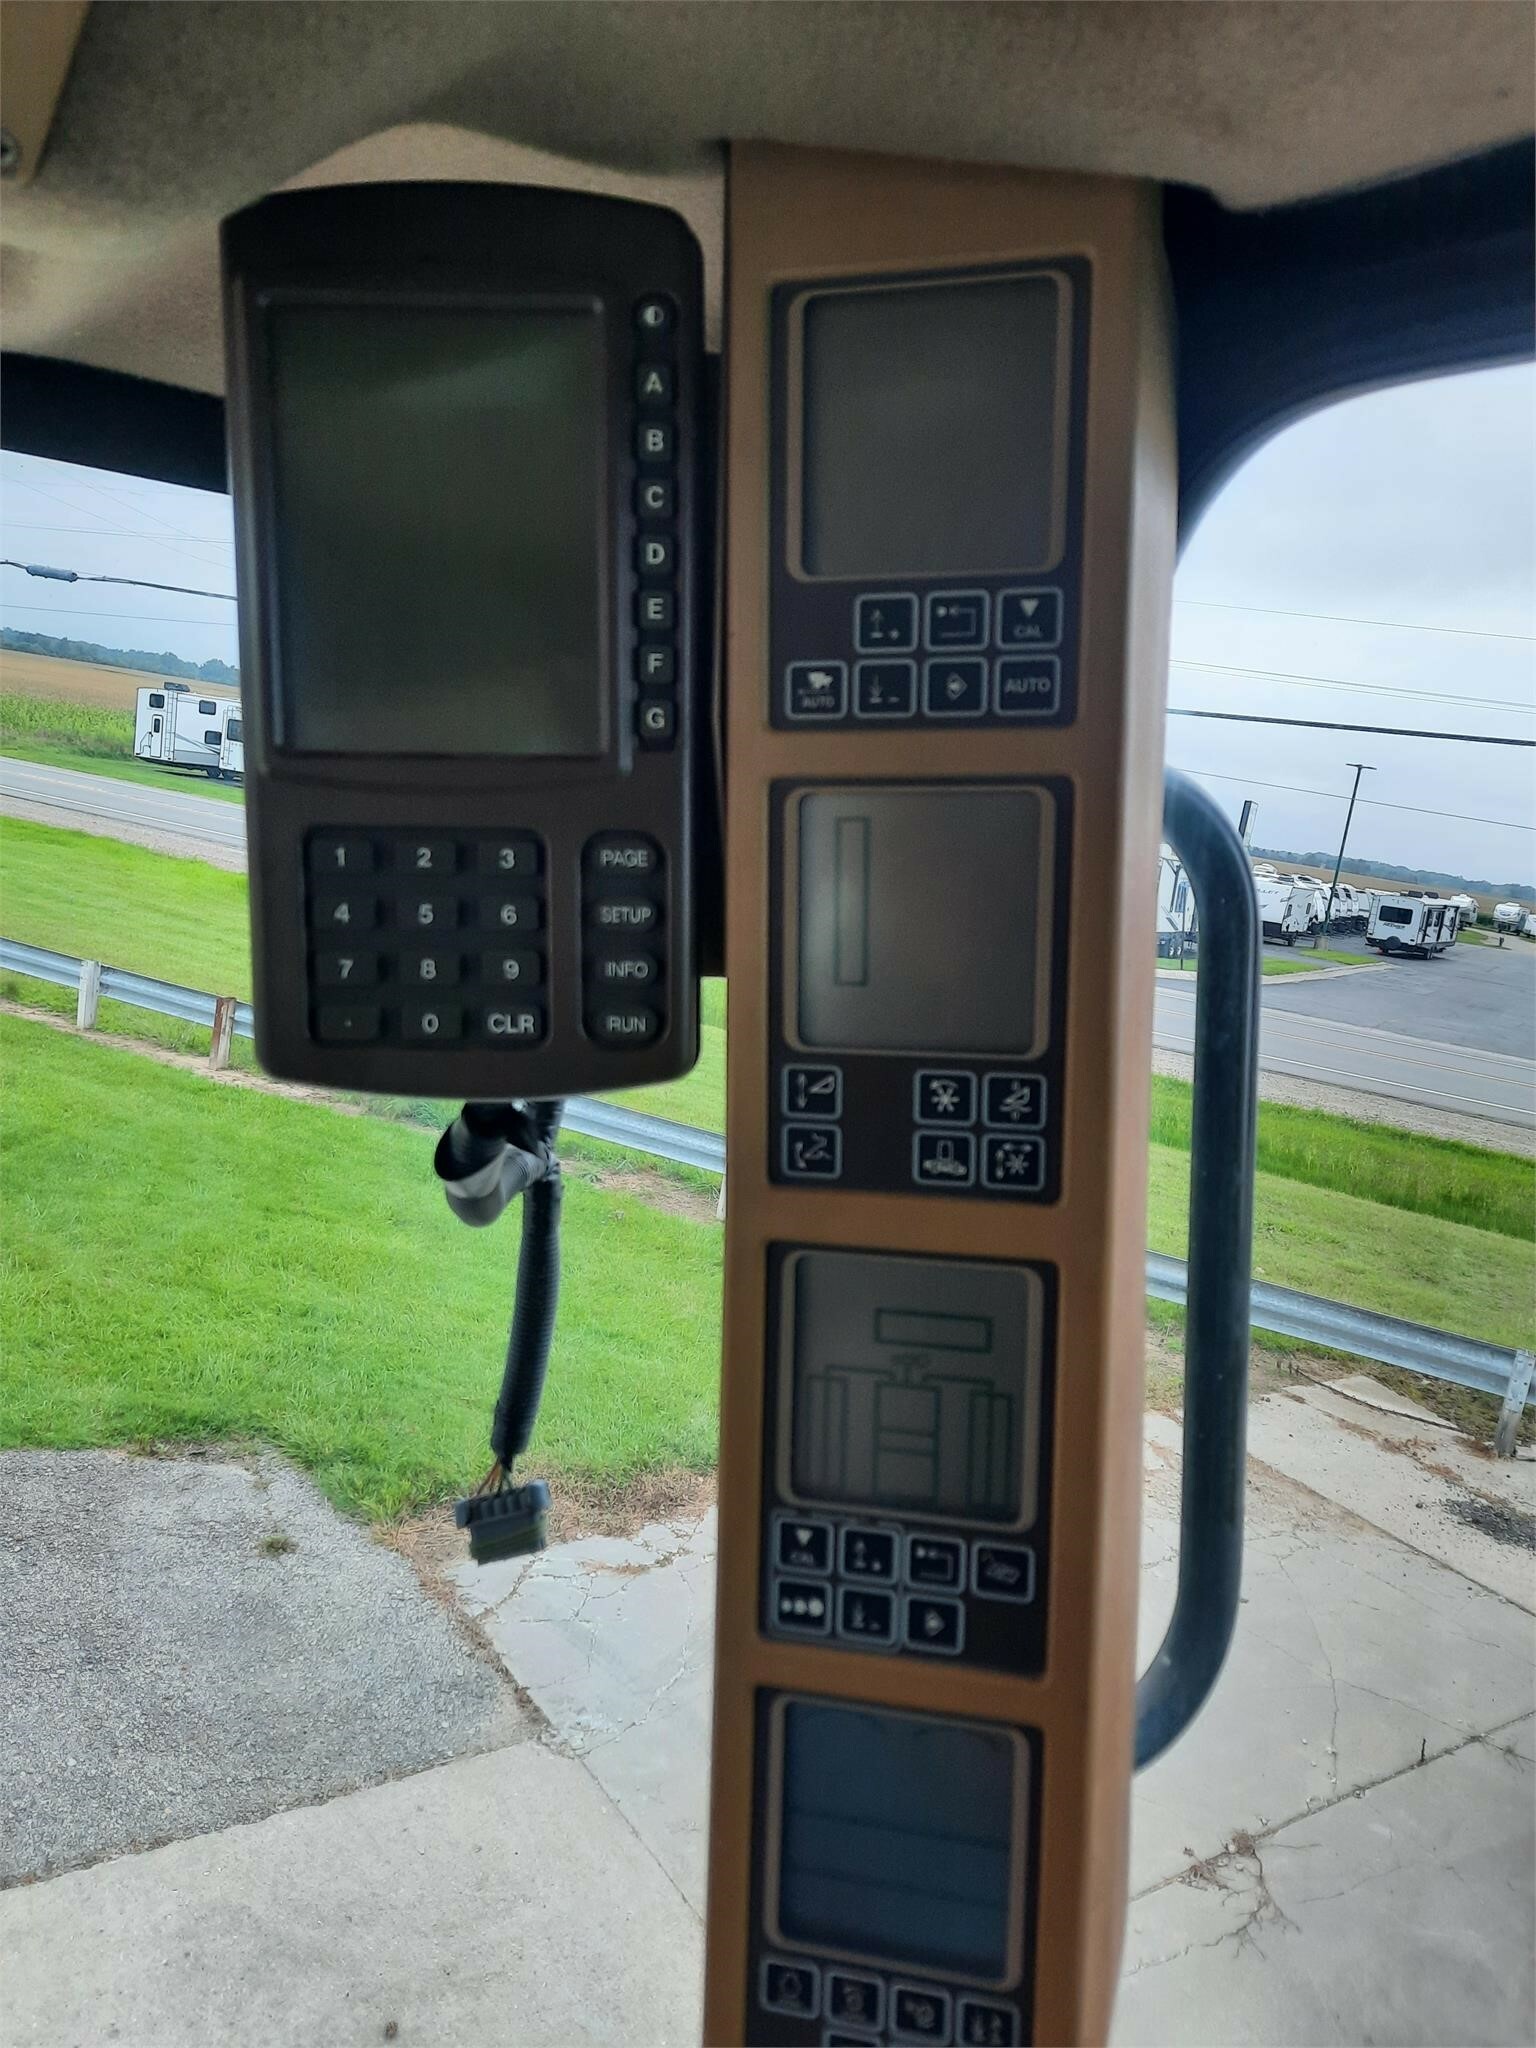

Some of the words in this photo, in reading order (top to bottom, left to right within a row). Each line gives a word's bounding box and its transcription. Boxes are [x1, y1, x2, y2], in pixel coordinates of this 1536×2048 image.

[644, 371, 664, 394] A
[645, 428, 665, 452] B
[645, 485, 665, 509] C
[645, 542, 666, 565] D
[646, 597, 664, 620] E
[647, 652, 664, 674] F
[1004, 676, 1051, 694] AUTO
[645, 706, 666, 730] G
[335, 846, 347, 867] 1
[416, 846, 433, 869] 2
[499, 847, 515, 870] 3
[601, 847, 649, 868] PAGE
[333, 902, 351, 923] 4
[417, 902, 434, 925] 5
[500, 903, 518, 926] 6
[601, 904, 652, 925] SETUP
[338, 958, 354, 979] 7
[419, 957, 437, 980] 8
[502, 958, 520, 980] 9
[606, 959, 649, 979] INFO
[487, 1011, 535, 1034] CLR
[607, 1014, 646, 1034] RUN
